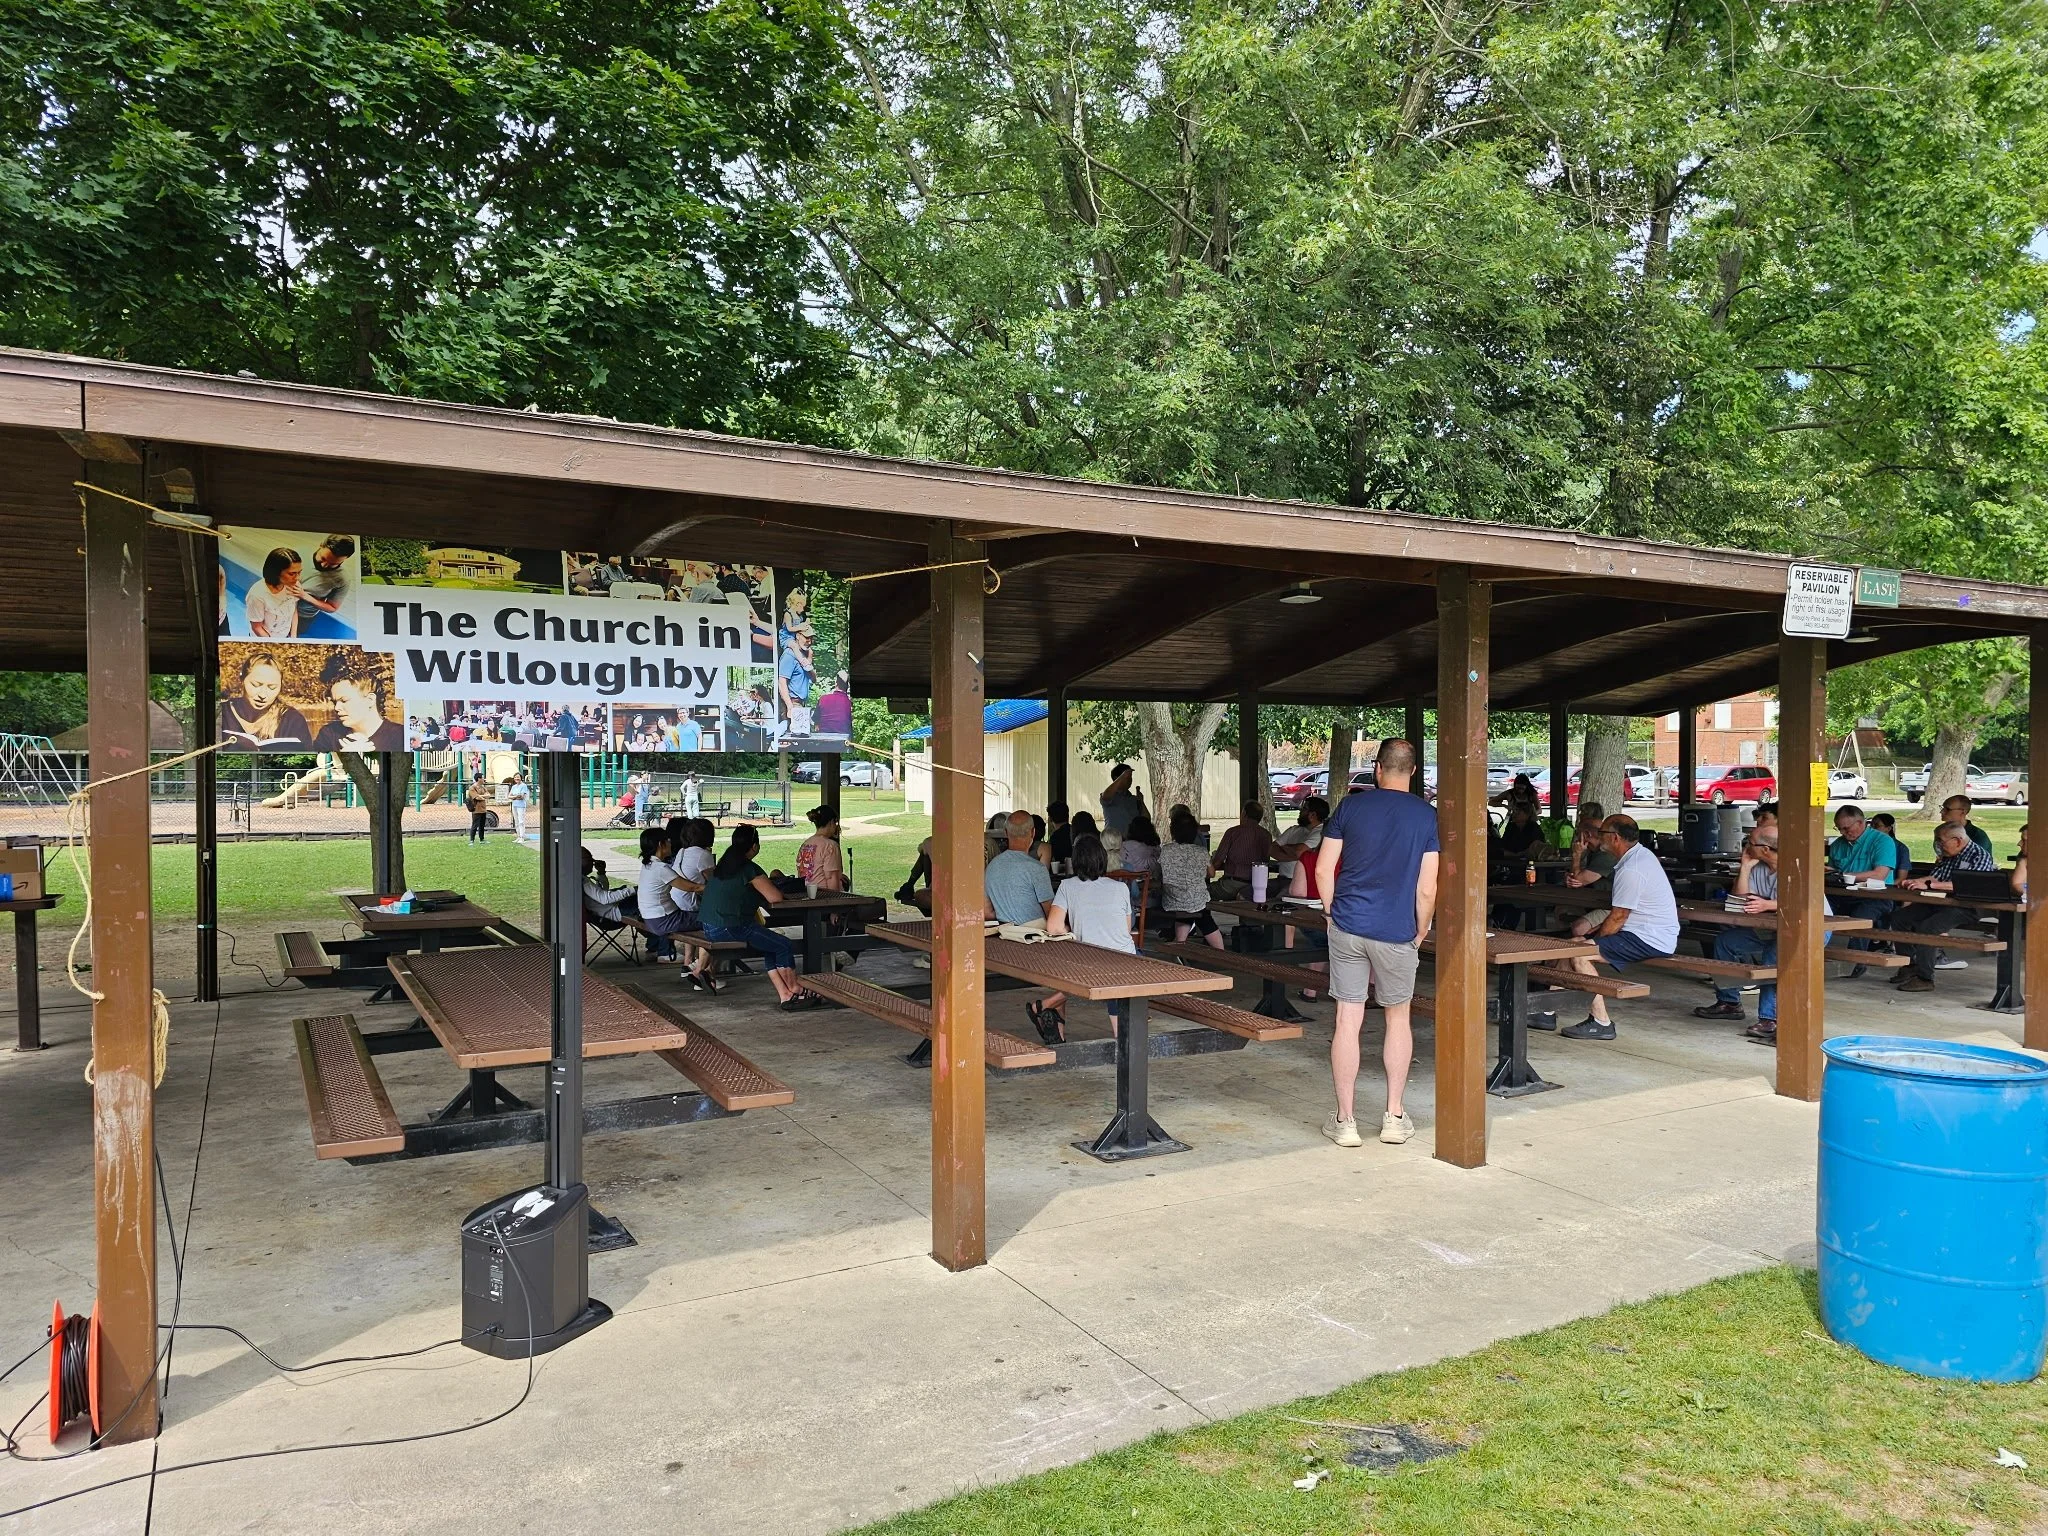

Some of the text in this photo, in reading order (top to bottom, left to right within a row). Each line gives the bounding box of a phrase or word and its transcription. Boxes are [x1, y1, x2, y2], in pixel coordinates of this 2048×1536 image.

[1795, 570, 1849, 584] RESERVABLE
[1802, 583, 1840, 595] PAVILION
[1863, 580, 1894, 597] EAST
[1815, 596, 1833, 605] holder
[1792, 603, 1846, 617] right of first usage
[374, 601, 741, 650] The Church in
[406, 649, 718, 699] Willoughby
